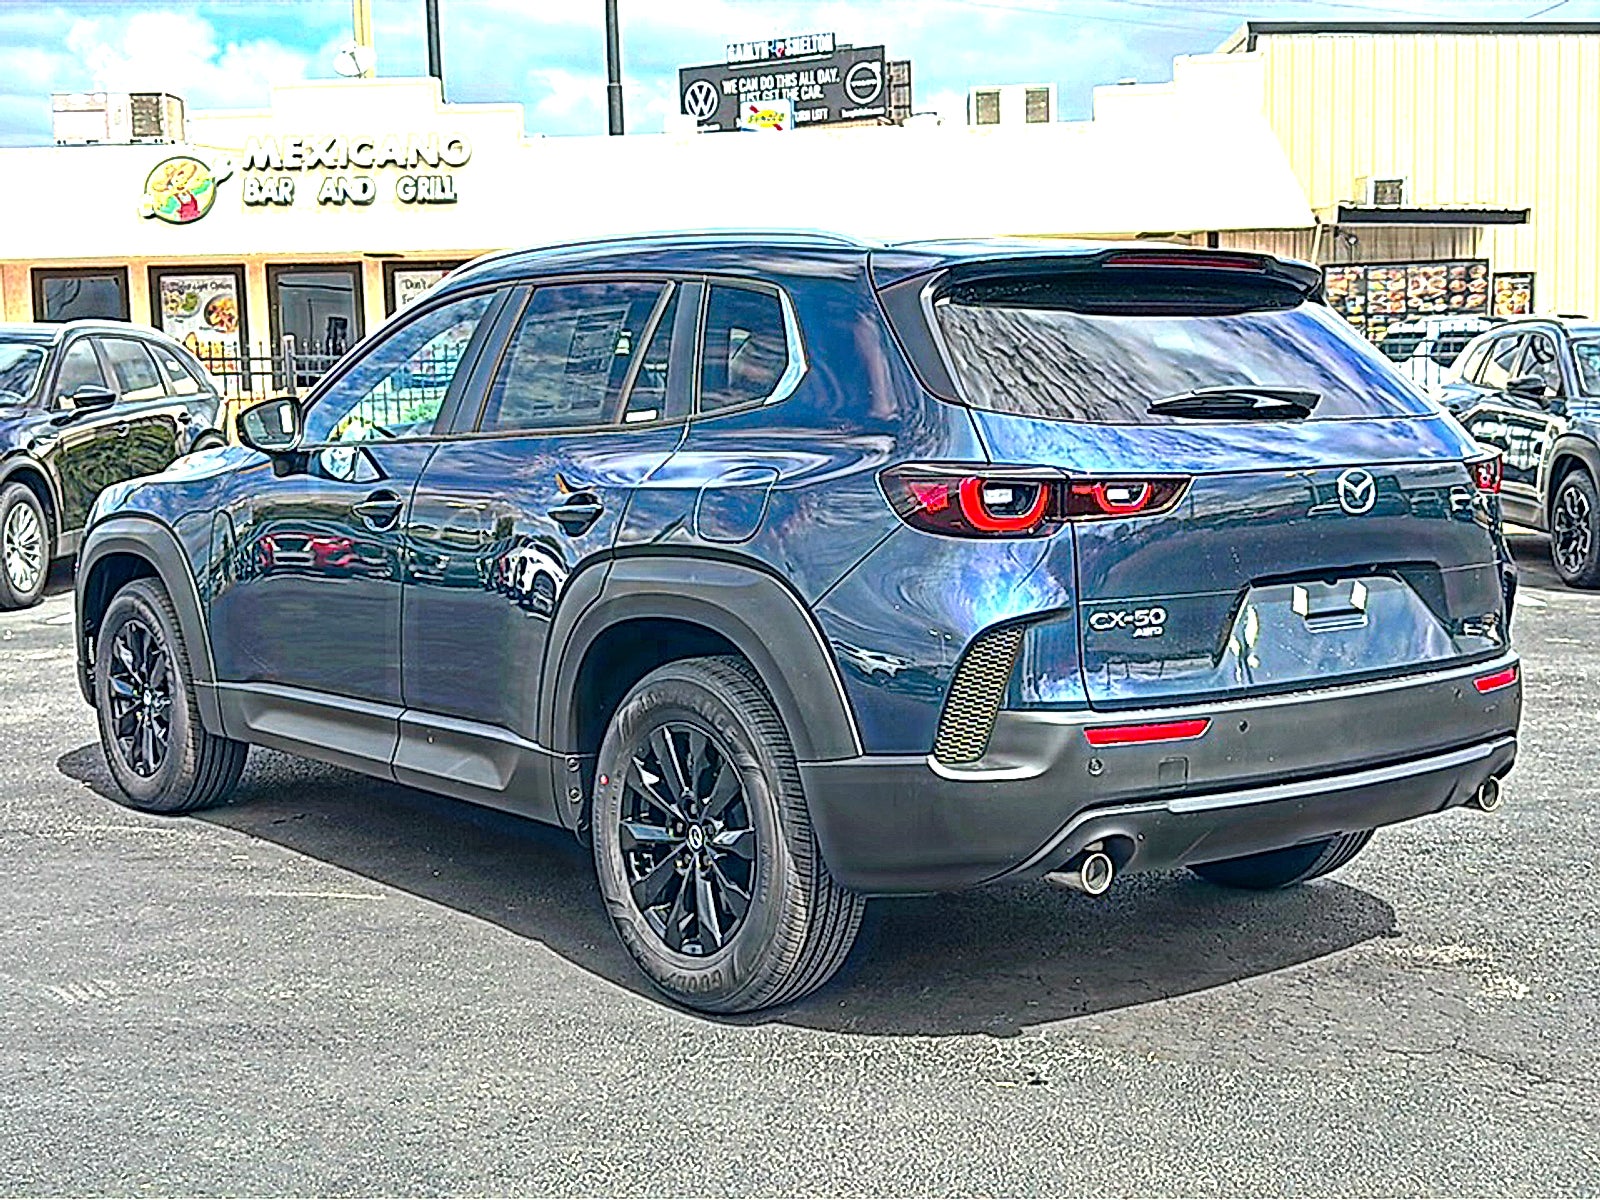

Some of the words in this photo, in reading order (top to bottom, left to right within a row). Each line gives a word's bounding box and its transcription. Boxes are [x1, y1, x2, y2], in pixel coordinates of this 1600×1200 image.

[721, 79, 738, 95] WE
[739, 77, 758, 92] CAN
[760, 75, 775, 90] DO
[775, 72, 798, 88] THIS
[799, 70, 816, 85] ALL
[782, 86, 800, 101] THE
[243, 135, 471, 171] MEXICANO
[243, 176, 294, 206] BAR
[318, 176, 376, 206] AND
[395, 175, 458, 204] GRILL
[1089, 607, 1167, 630] CX-50
